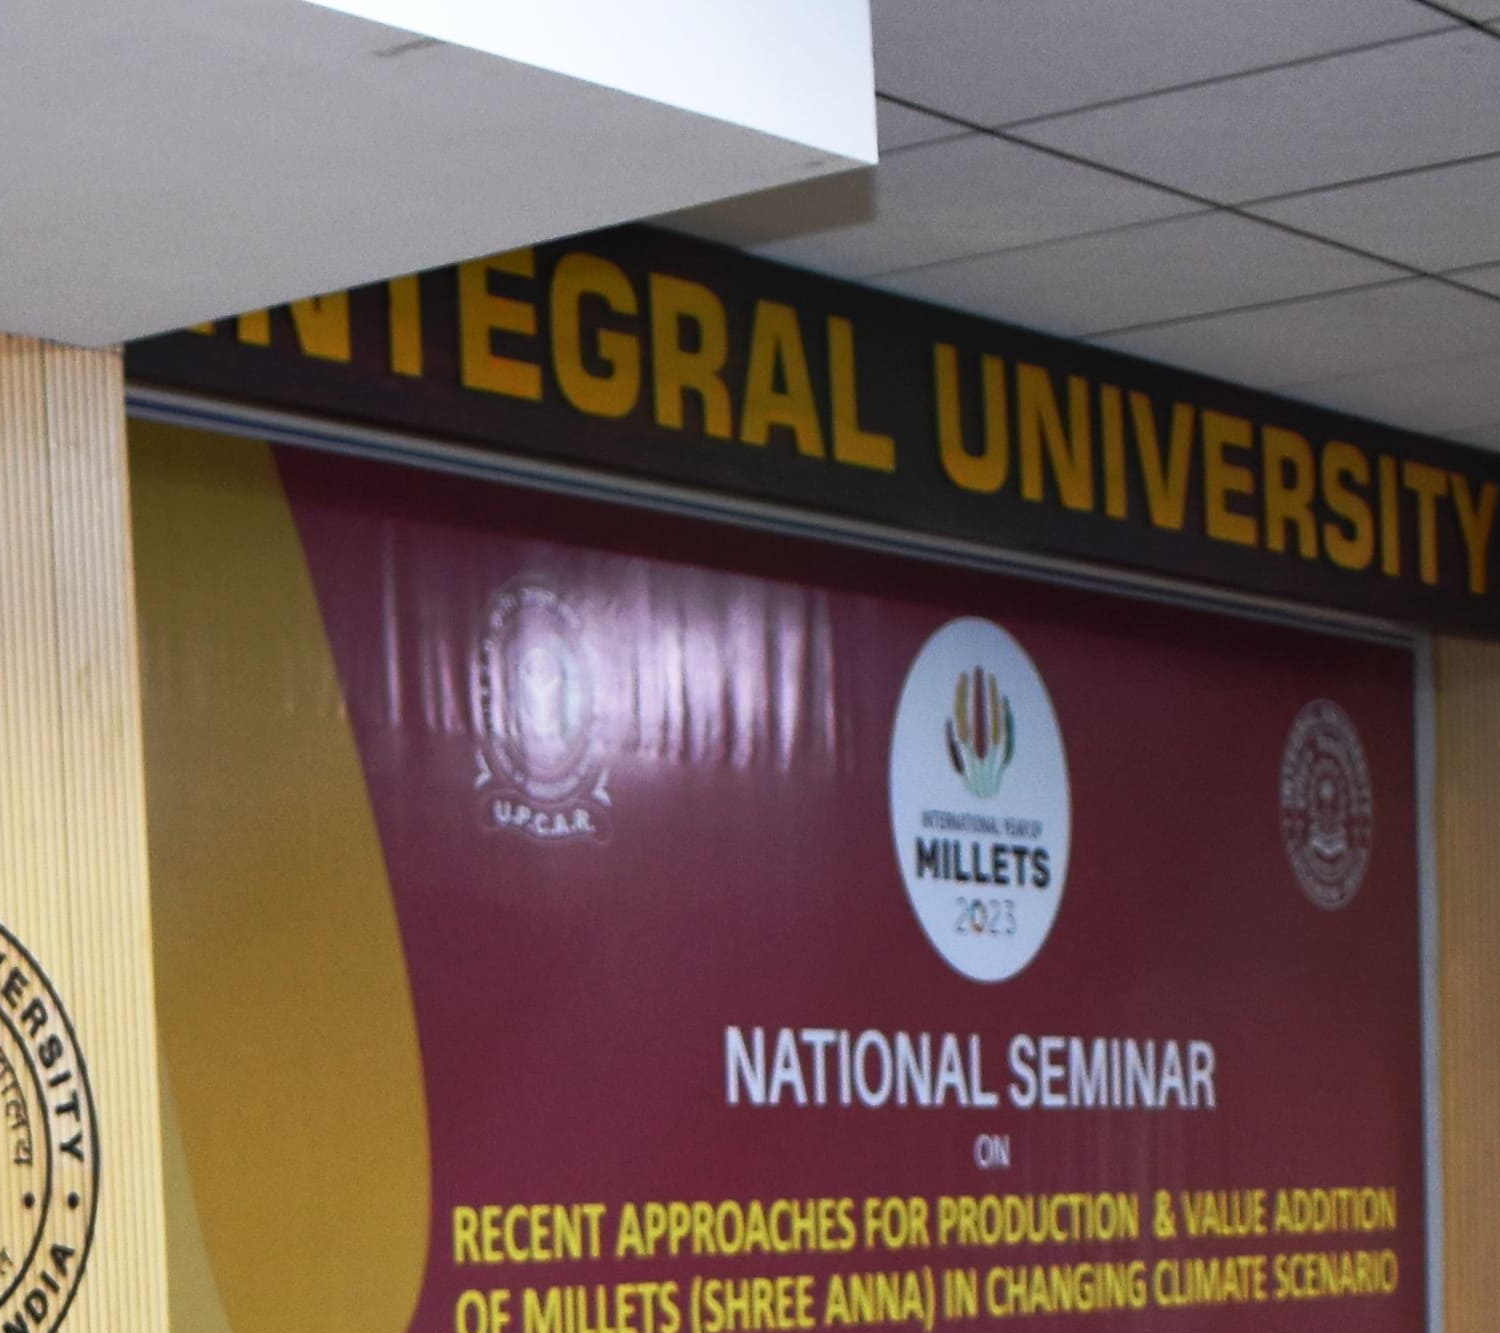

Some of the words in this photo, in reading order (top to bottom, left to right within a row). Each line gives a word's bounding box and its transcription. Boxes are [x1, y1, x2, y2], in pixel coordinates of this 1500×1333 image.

[933, 341, 1499, 594] UNIVERSITY
[915, 836, 1051, 889] MILLETS
[954, 897, 1016, 936] 2023
[724, 1025, 998, 1106] NATIONAL
[1007, 1033, 1218, 1110] SEMINAR
[973, 1133, 1011, 1169] ON
[453, 1202, 605, 1263] RECENT
[616, 1198, 856, 1258] APPROACHES
[864, 1196, 930, 1250] FOR
[938, 1193, 1140, 1245] PRODUCTION
[1152, 1188, 1176, 1239] &
[1181, 1188, 1267, 1238] VALUE
[1273, 1186, 1398, 1232] ADDITION
[823, 1266, 936, 1333] ANNA)
[943, 1269, 979, 1320] IN
[985, 1260, 1147, 1318] CHANGING
[1152, 1254, 1268, 1304] CLIMATE
[1273, 1249, 1399, 1299] SCENARIO
